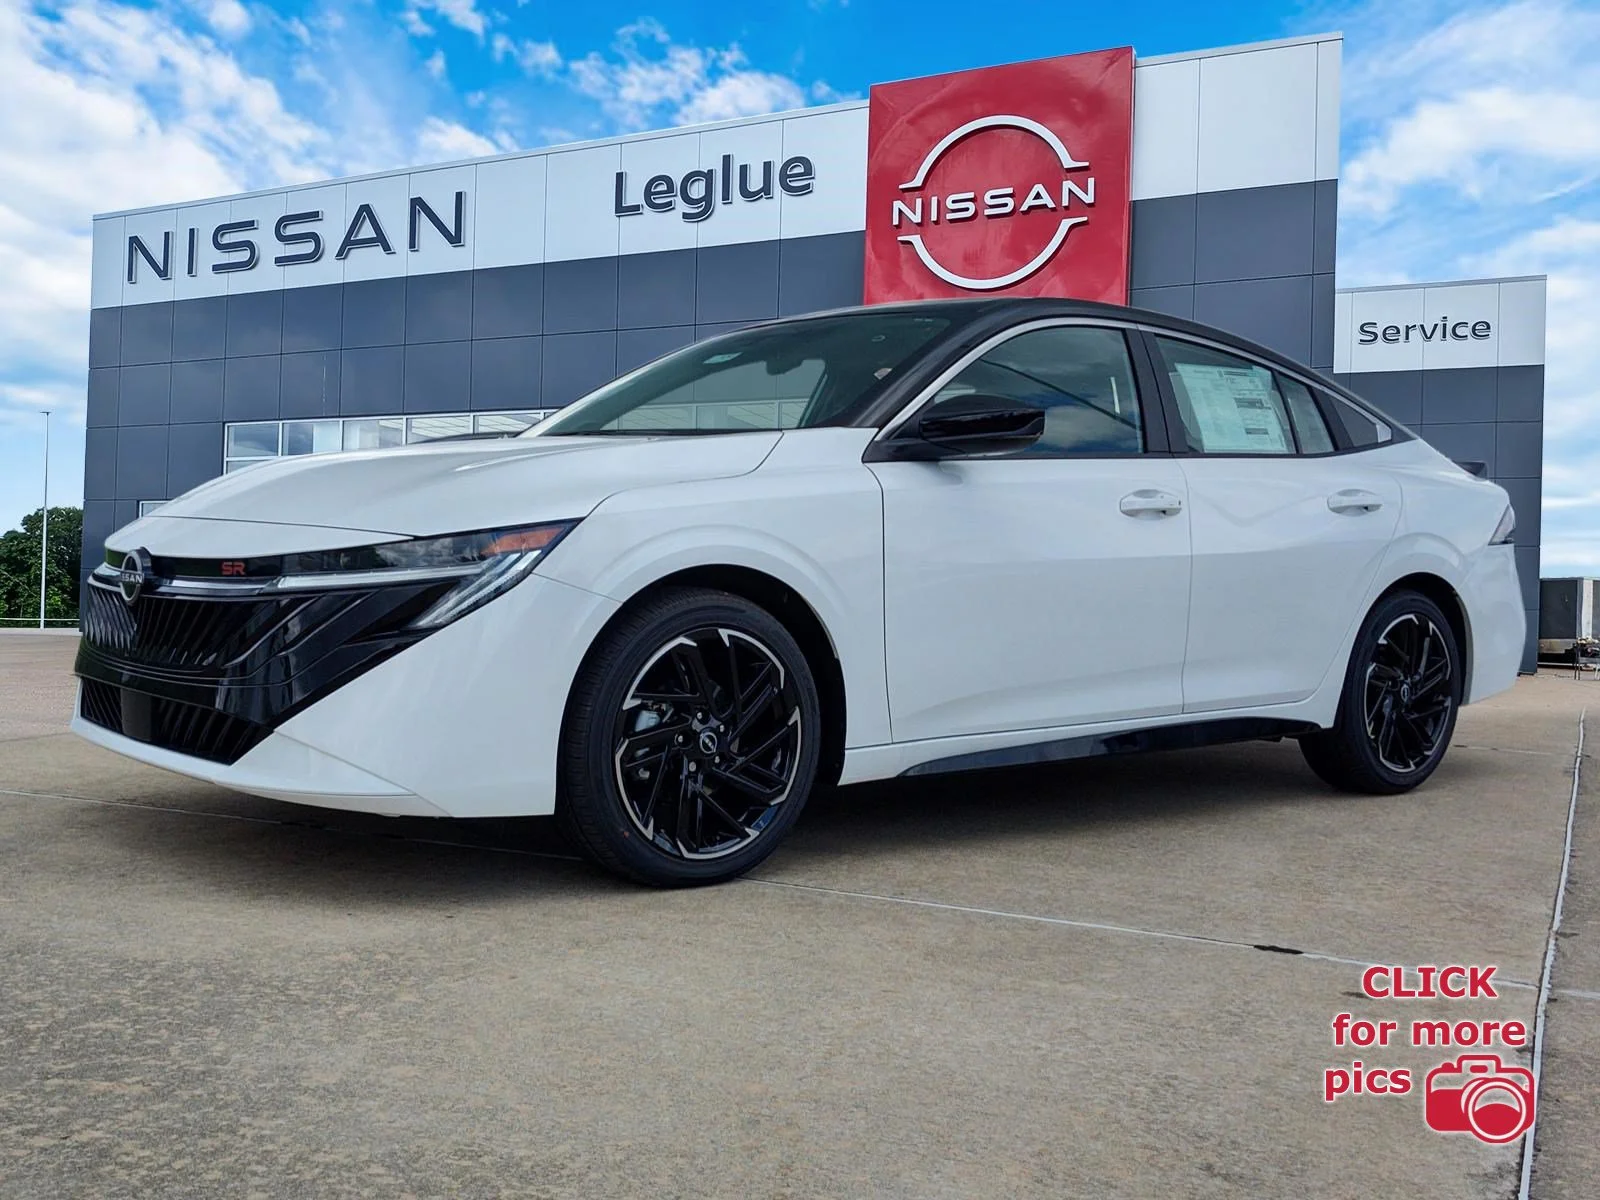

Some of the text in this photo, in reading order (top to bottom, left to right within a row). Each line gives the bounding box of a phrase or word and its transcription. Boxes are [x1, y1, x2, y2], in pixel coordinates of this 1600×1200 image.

[614, 154, 815, 221] Leglue
[892, 178, 1096, 226] NISSAN
[128, 191, 465, 284] NISSAN
[1358, 316, 1491, 344] Service
[222, 561, 246, 576] SR
